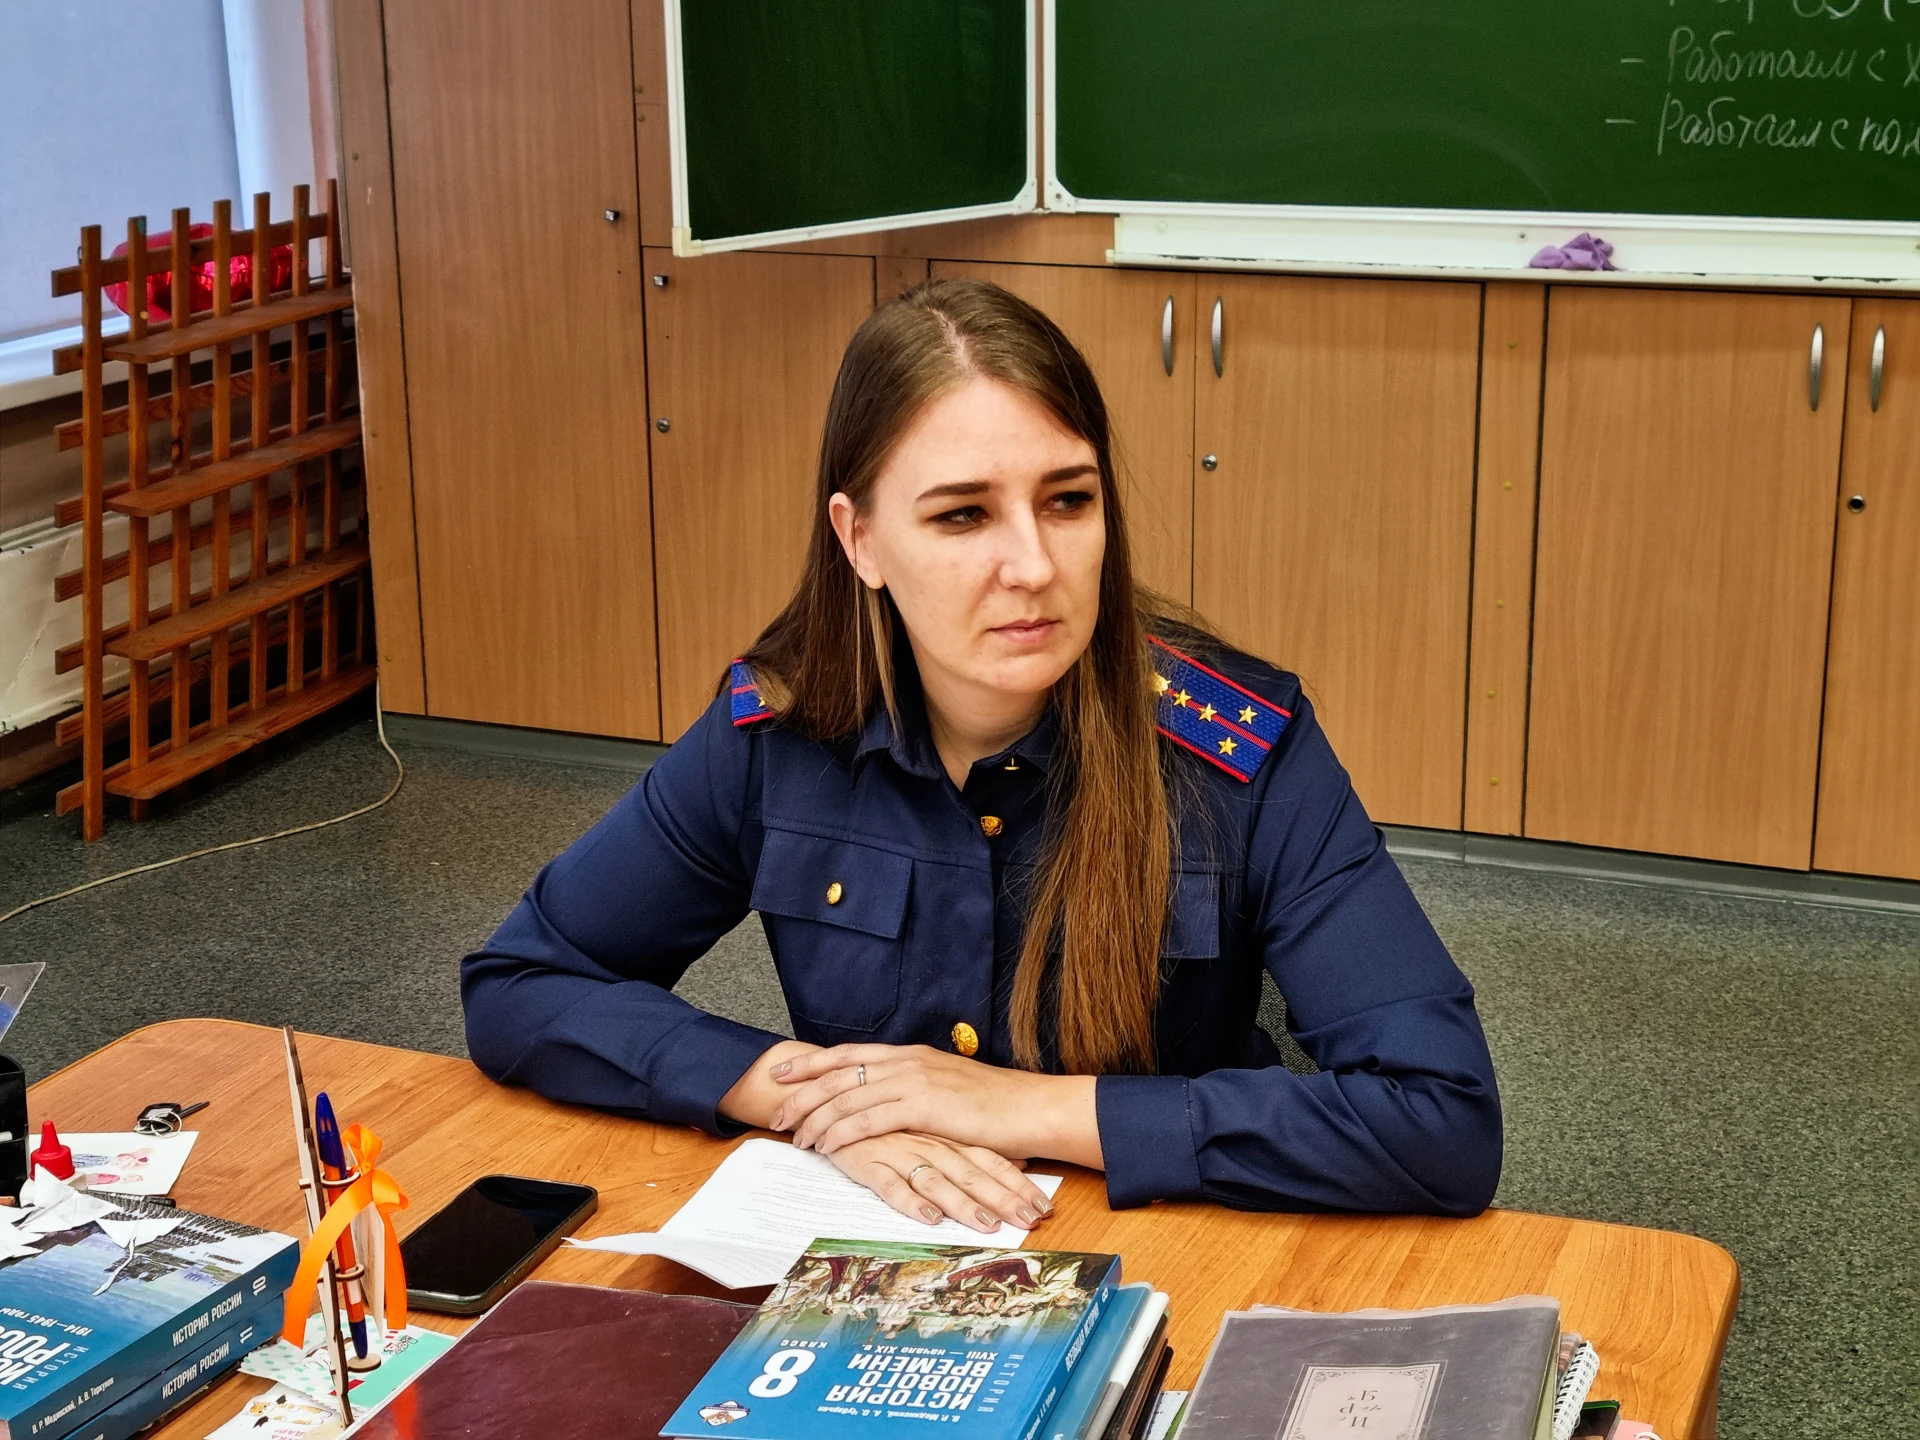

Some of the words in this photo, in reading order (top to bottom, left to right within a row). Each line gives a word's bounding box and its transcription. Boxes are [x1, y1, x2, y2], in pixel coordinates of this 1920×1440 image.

[252, 1275, 267, 1296] 10
[172, 1311, 209, 1347] ИСТОРИЯ
[211, 1291, 243, 1323] РОССИИ
[780, 1339, 828, 1349] класс
[900, 1347, 947, 1356] начало
[12, 1345, 89, 1390] ИСТОРИЯ
[162, 1363, 197, 1400] ИСТОРИЯ
[199, 1341, 230, 1374] РОССИИ
[748, 1348, 817, 1398] 8
[847, 1353, 994, 1378] ВРЕМЕНИ
[858, 1370, 984, 1394] НОВОГО
[977, 1354, 1025, 1413] ИСТОРИЯ
[824, 1384, 975, 1411] ИСТОРИЯ
